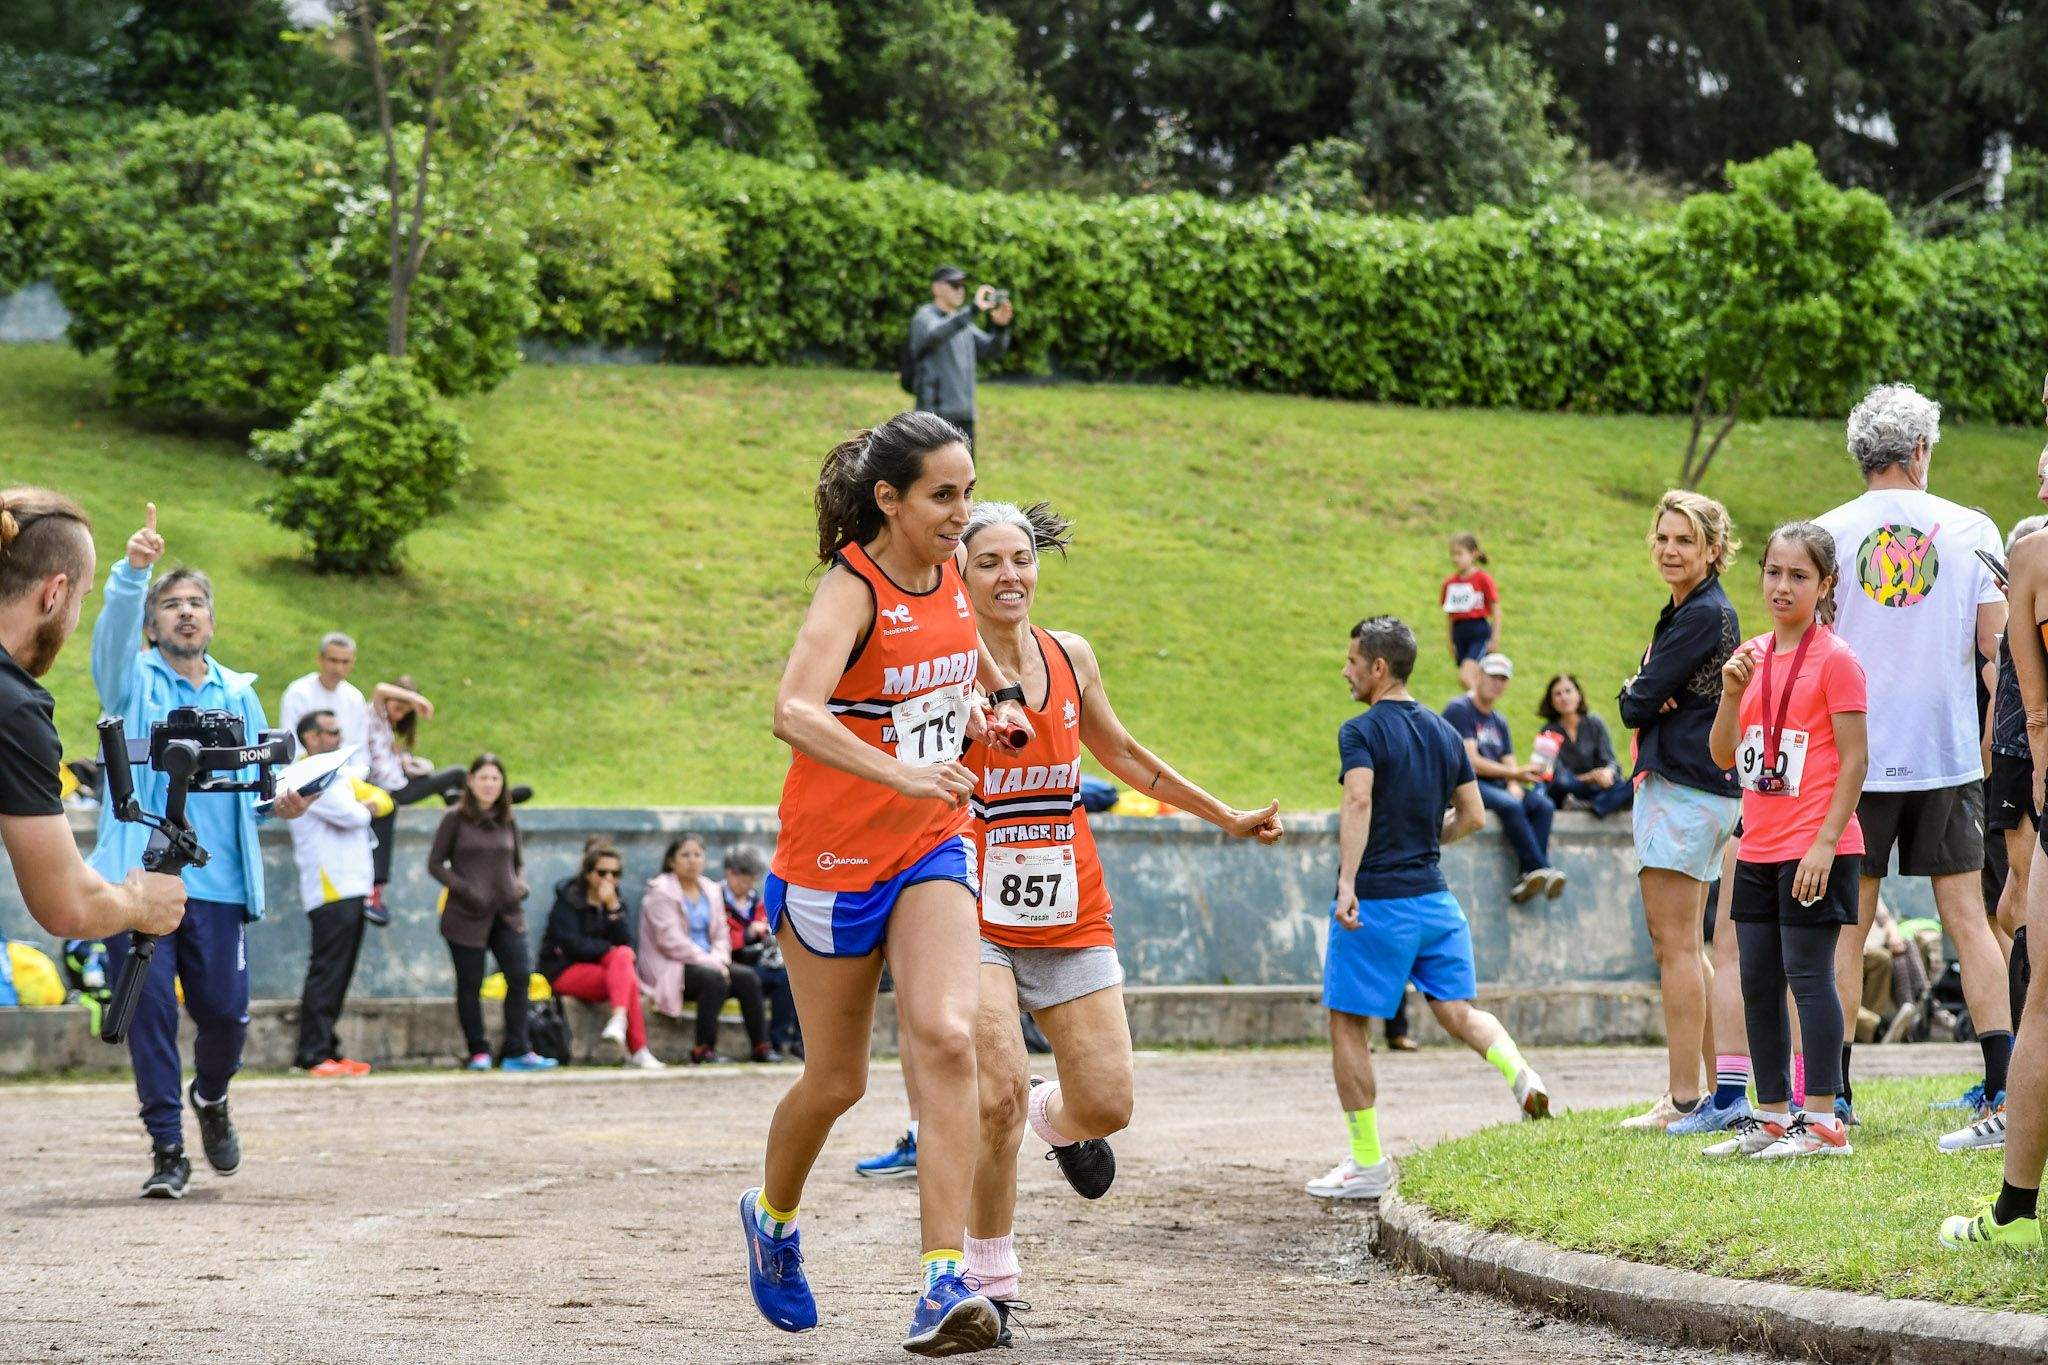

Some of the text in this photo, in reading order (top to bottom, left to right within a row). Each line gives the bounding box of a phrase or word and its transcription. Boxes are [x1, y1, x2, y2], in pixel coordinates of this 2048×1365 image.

[239, 746, 271, 762] RONIN
[983, 754, 1081, 796] MADRI
[1000, 873, 1062, 908] 857
[1056, 910, 1073, 919] 2023
